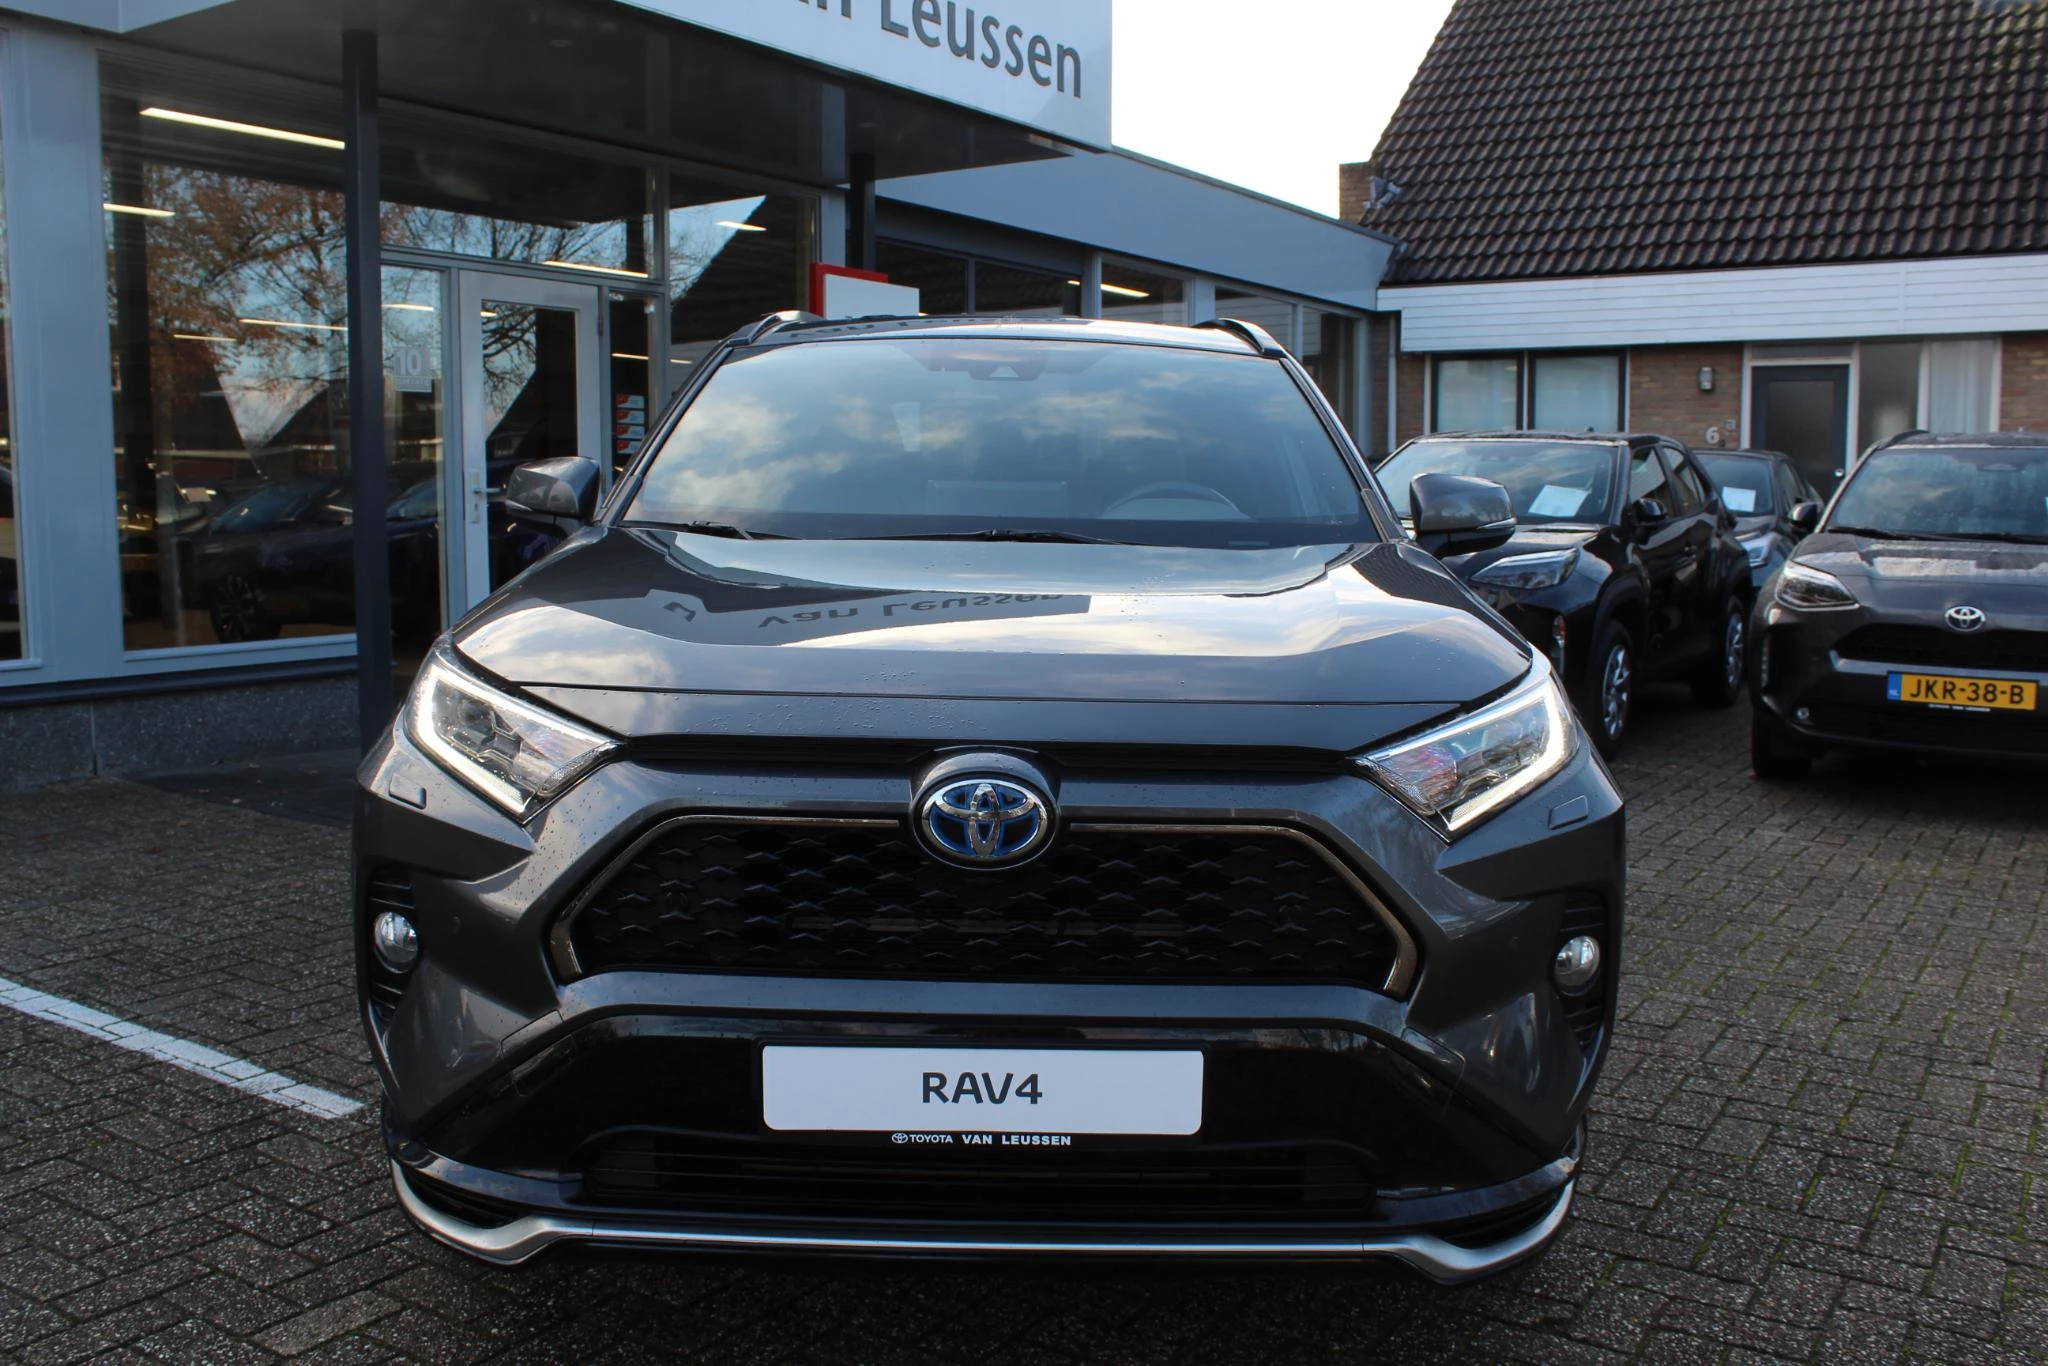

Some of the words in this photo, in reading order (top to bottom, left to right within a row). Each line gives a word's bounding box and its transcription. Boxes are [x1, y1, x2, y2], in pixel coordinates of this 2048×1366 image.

[1706, 426, 1720, 444] 6
[1910, 679, 2024, 704] JKR-38-B
[922, 1071, 1043, 1105] RAV4
[909, 1133, 954, 1144] TOYOTA
[961, 1134, 993, 1145] VAN
[1001, 1134, 1071, 1146] LEUSSEN
